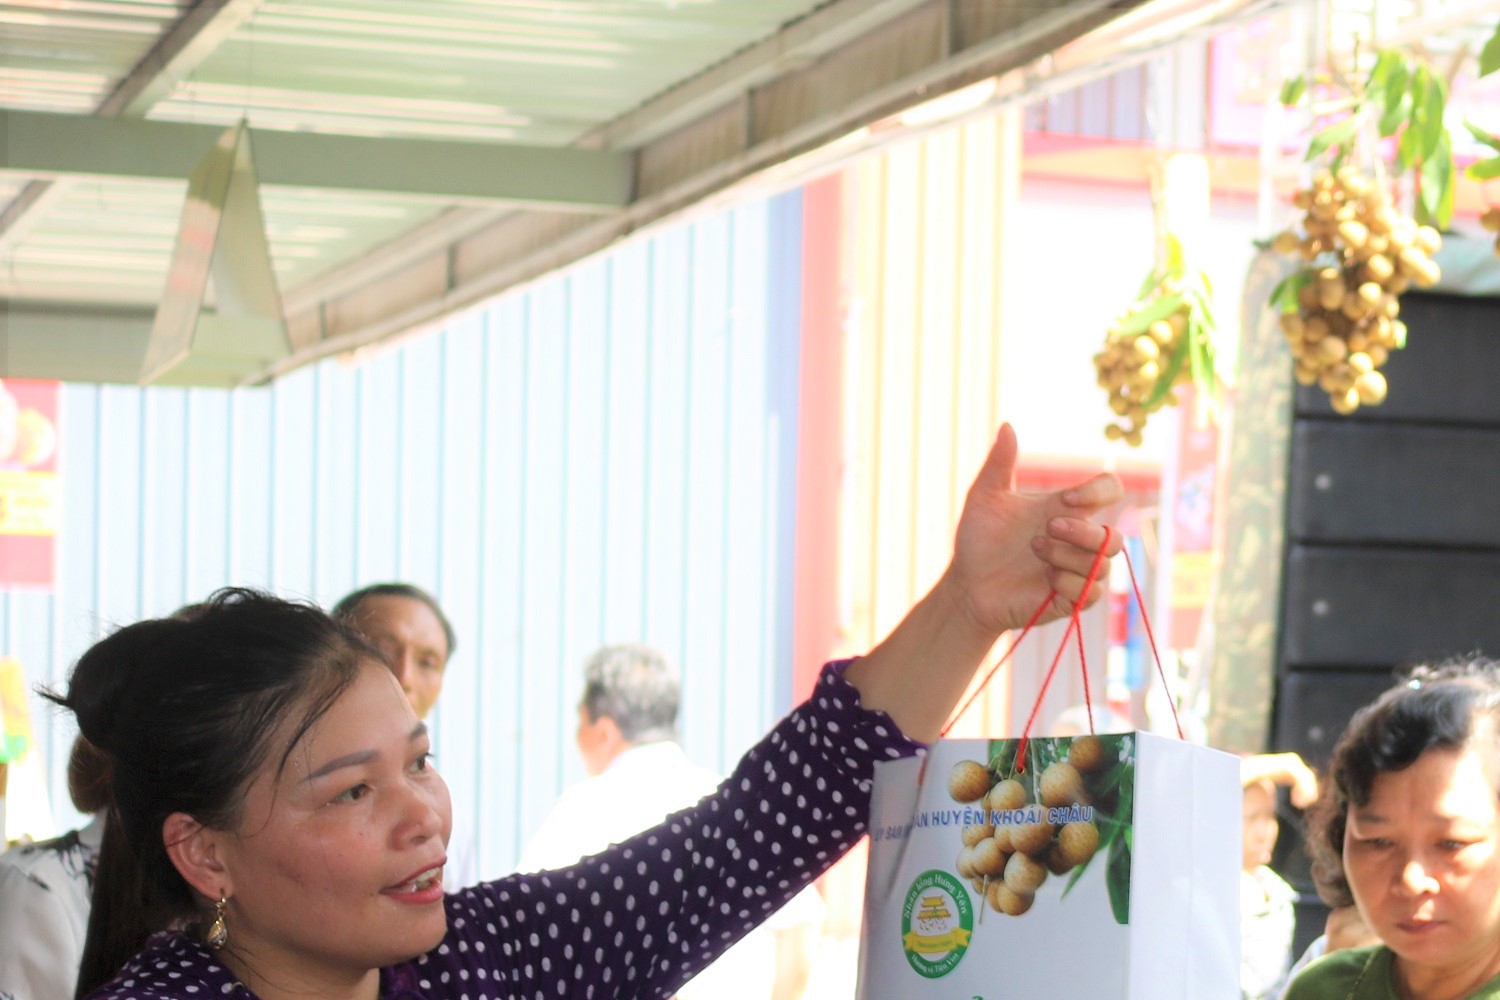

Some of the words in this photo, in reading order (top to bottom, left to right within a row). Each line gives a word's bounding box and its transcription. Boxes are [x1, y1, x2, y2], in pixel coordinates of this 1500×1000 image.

[932, 806, 985, 830] HUYỆN
[990, 806, 1042, 826] KHOÁI
[1048, 804, 1093, 824] CHÂU
